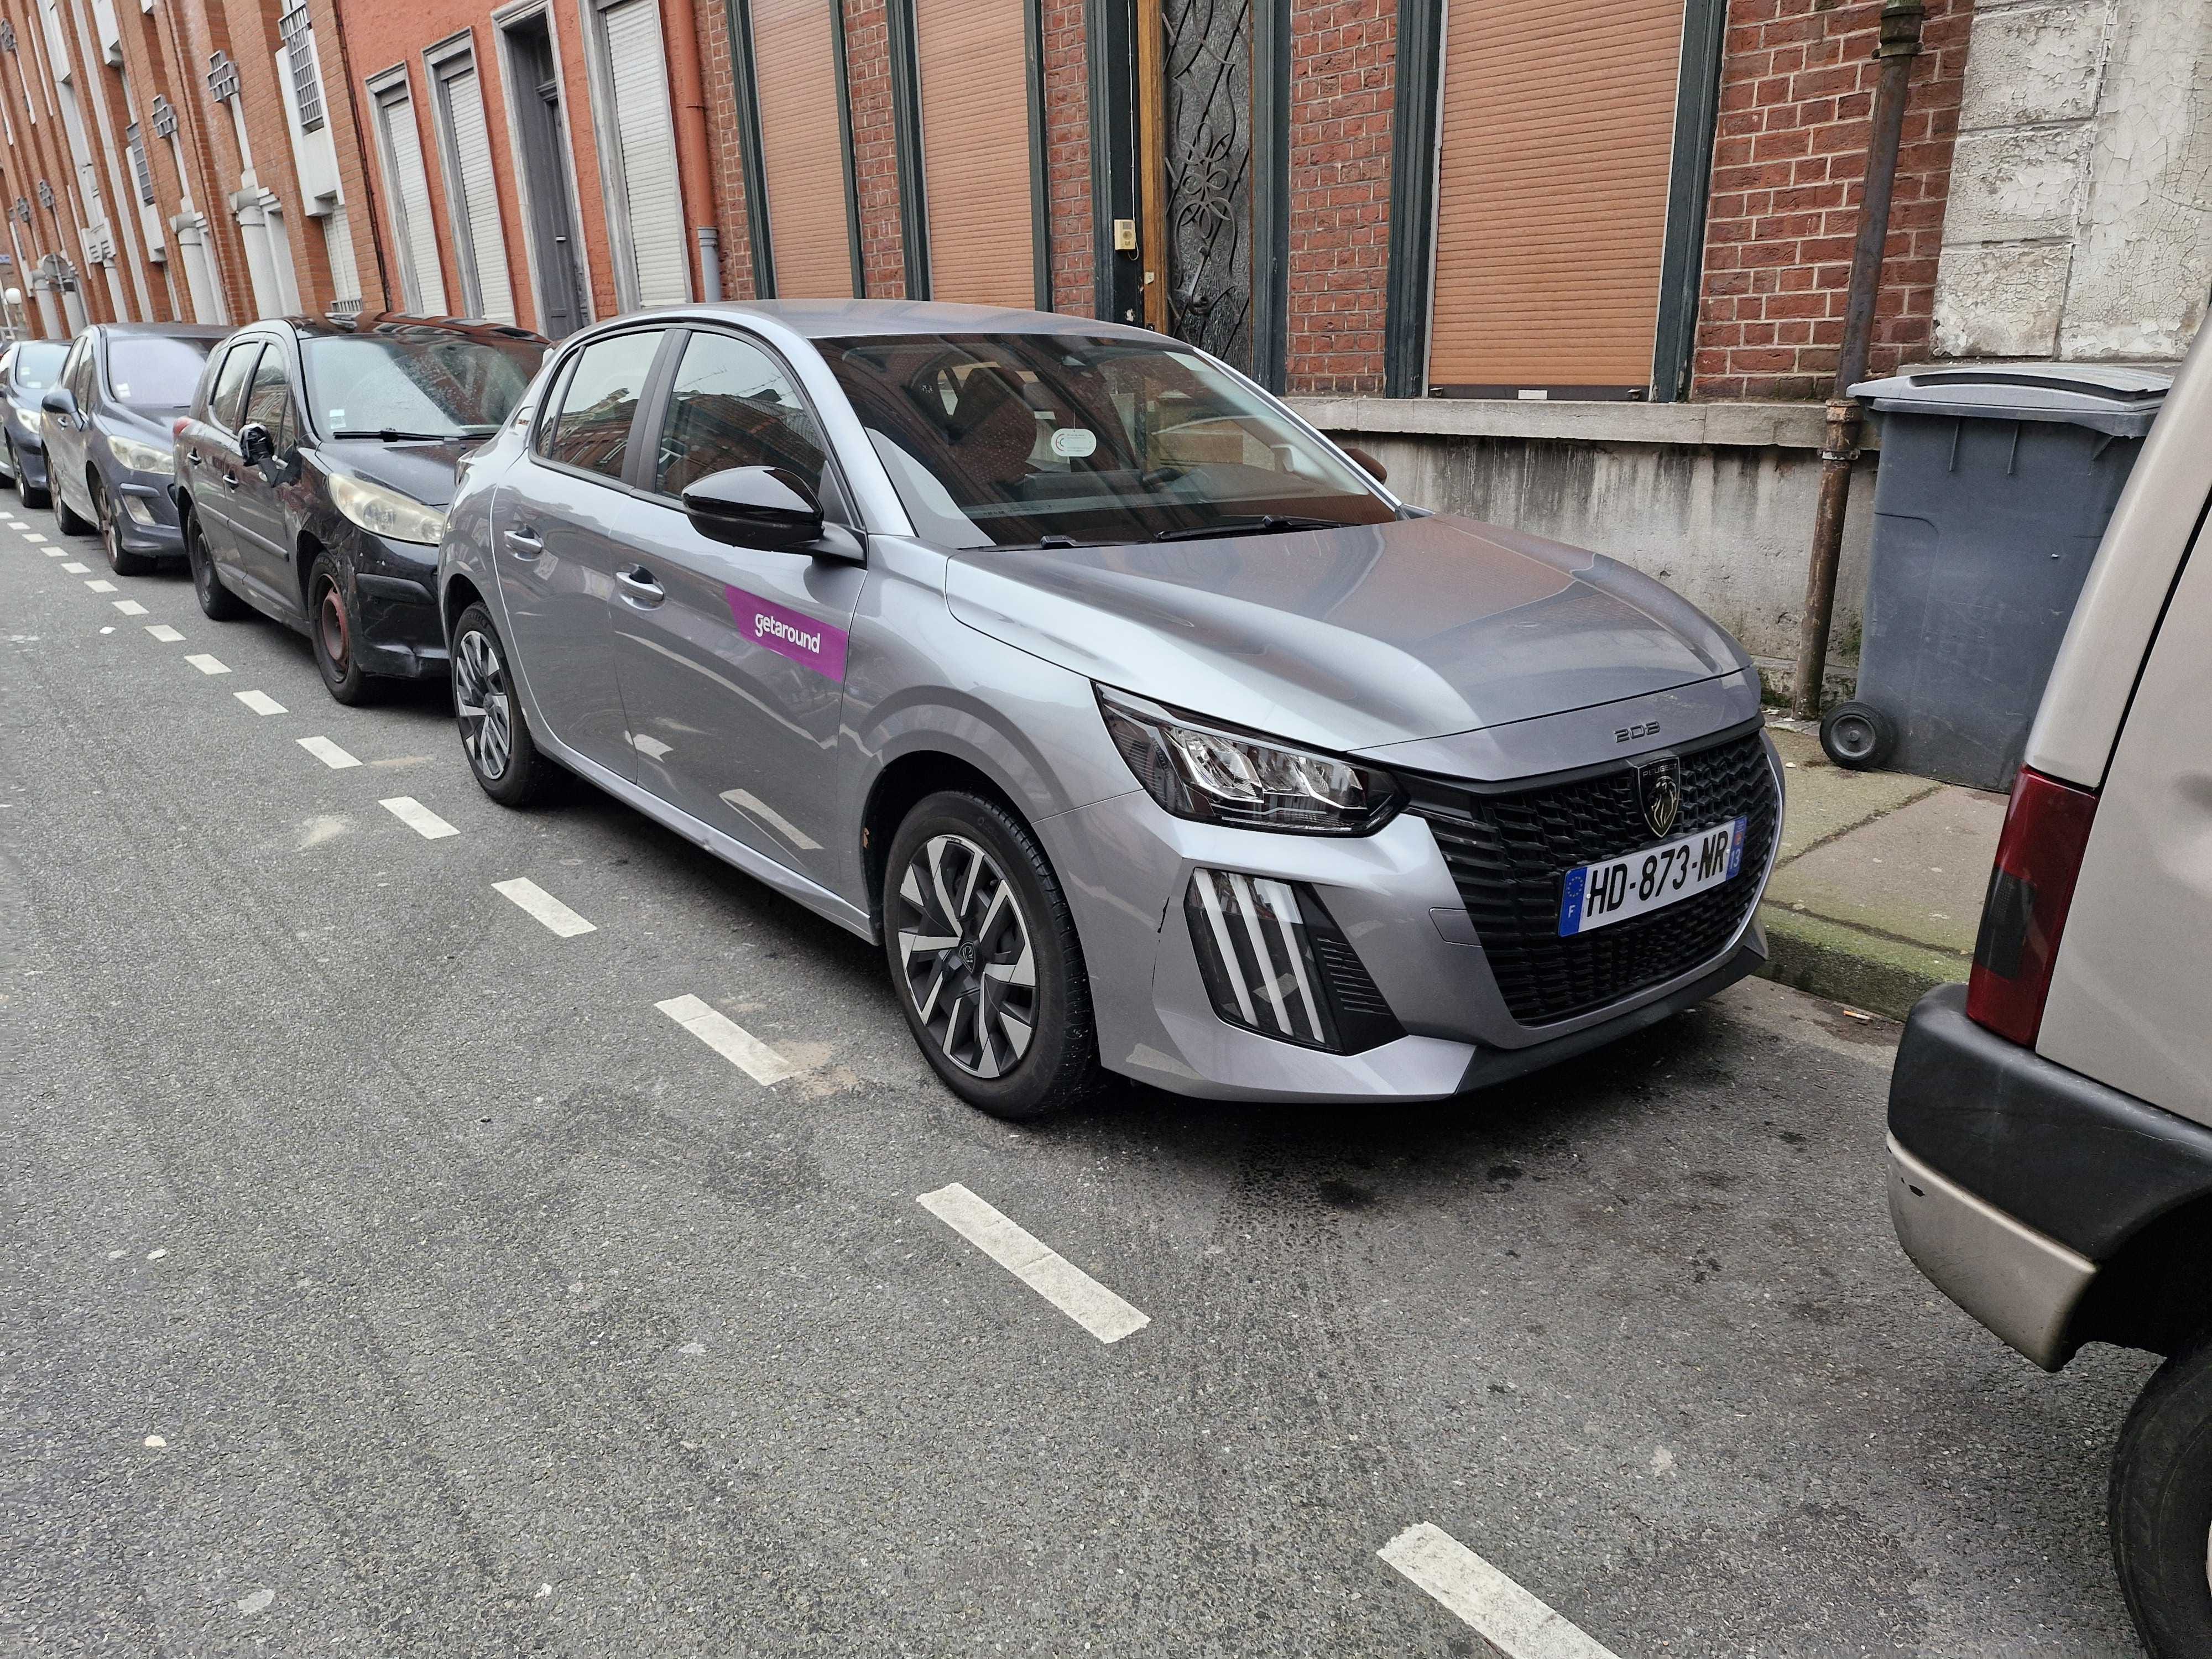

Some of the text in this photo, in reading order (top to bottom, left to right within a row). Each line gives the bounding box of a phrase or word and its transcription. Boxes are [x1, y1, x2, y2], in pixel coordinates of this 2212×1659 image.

[755, 613, 821, 654] getaround
[1614, 721, 1660, 743] 208
[1730, 848, 1741, 869] 13
[1587, 831, 1728, 917] HD-873-NR
[1568, 905, 1575, 918] F
